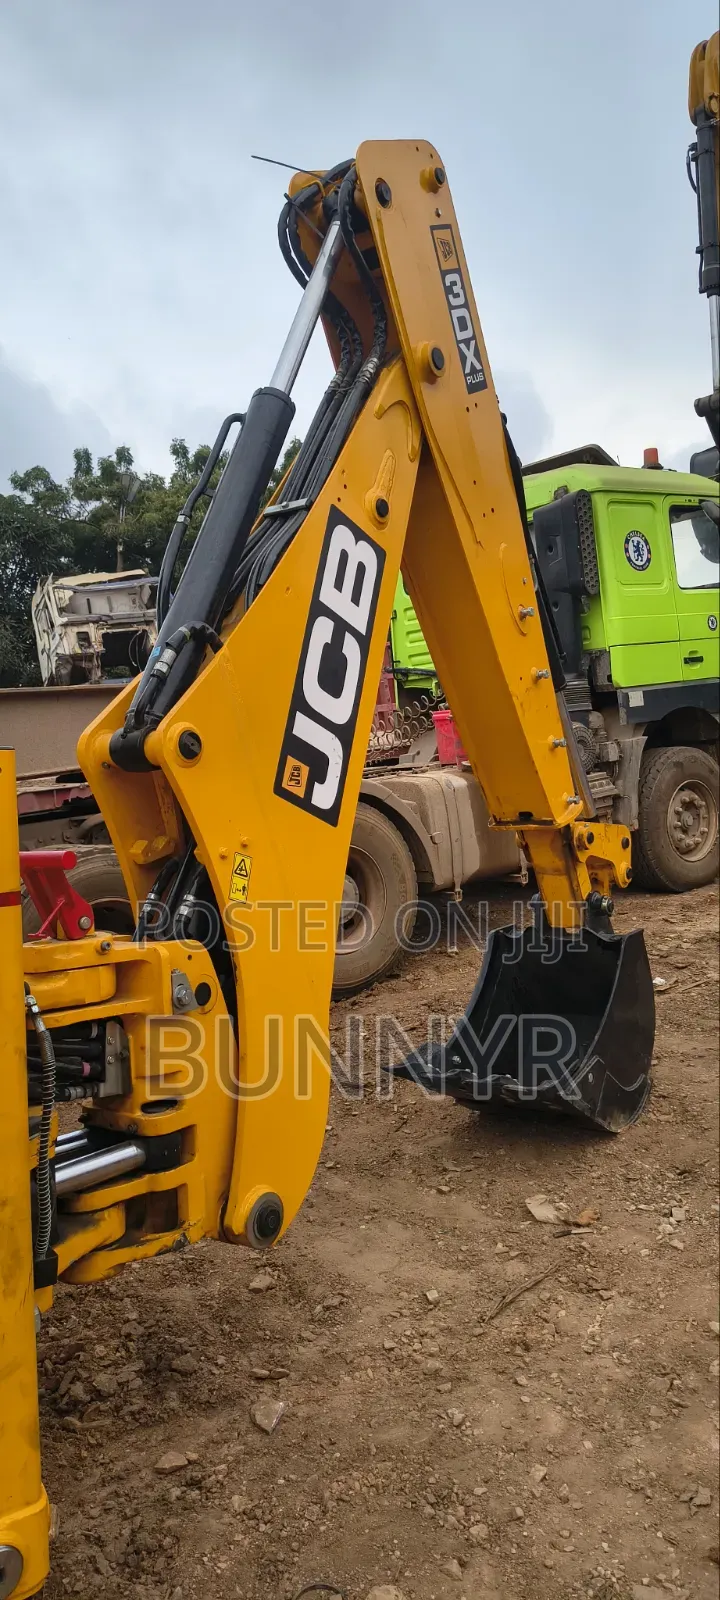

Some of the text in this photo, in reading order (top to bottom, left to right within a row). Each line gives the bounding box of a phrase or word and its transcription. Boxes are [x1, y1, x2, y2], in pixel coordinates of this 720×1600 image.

[444, 273, 482, 374] 3DX
[466, 372, 485, 385] PLUS
[292, 524, 378, 810] JCB
[288, 766, 301, 785] JCB
